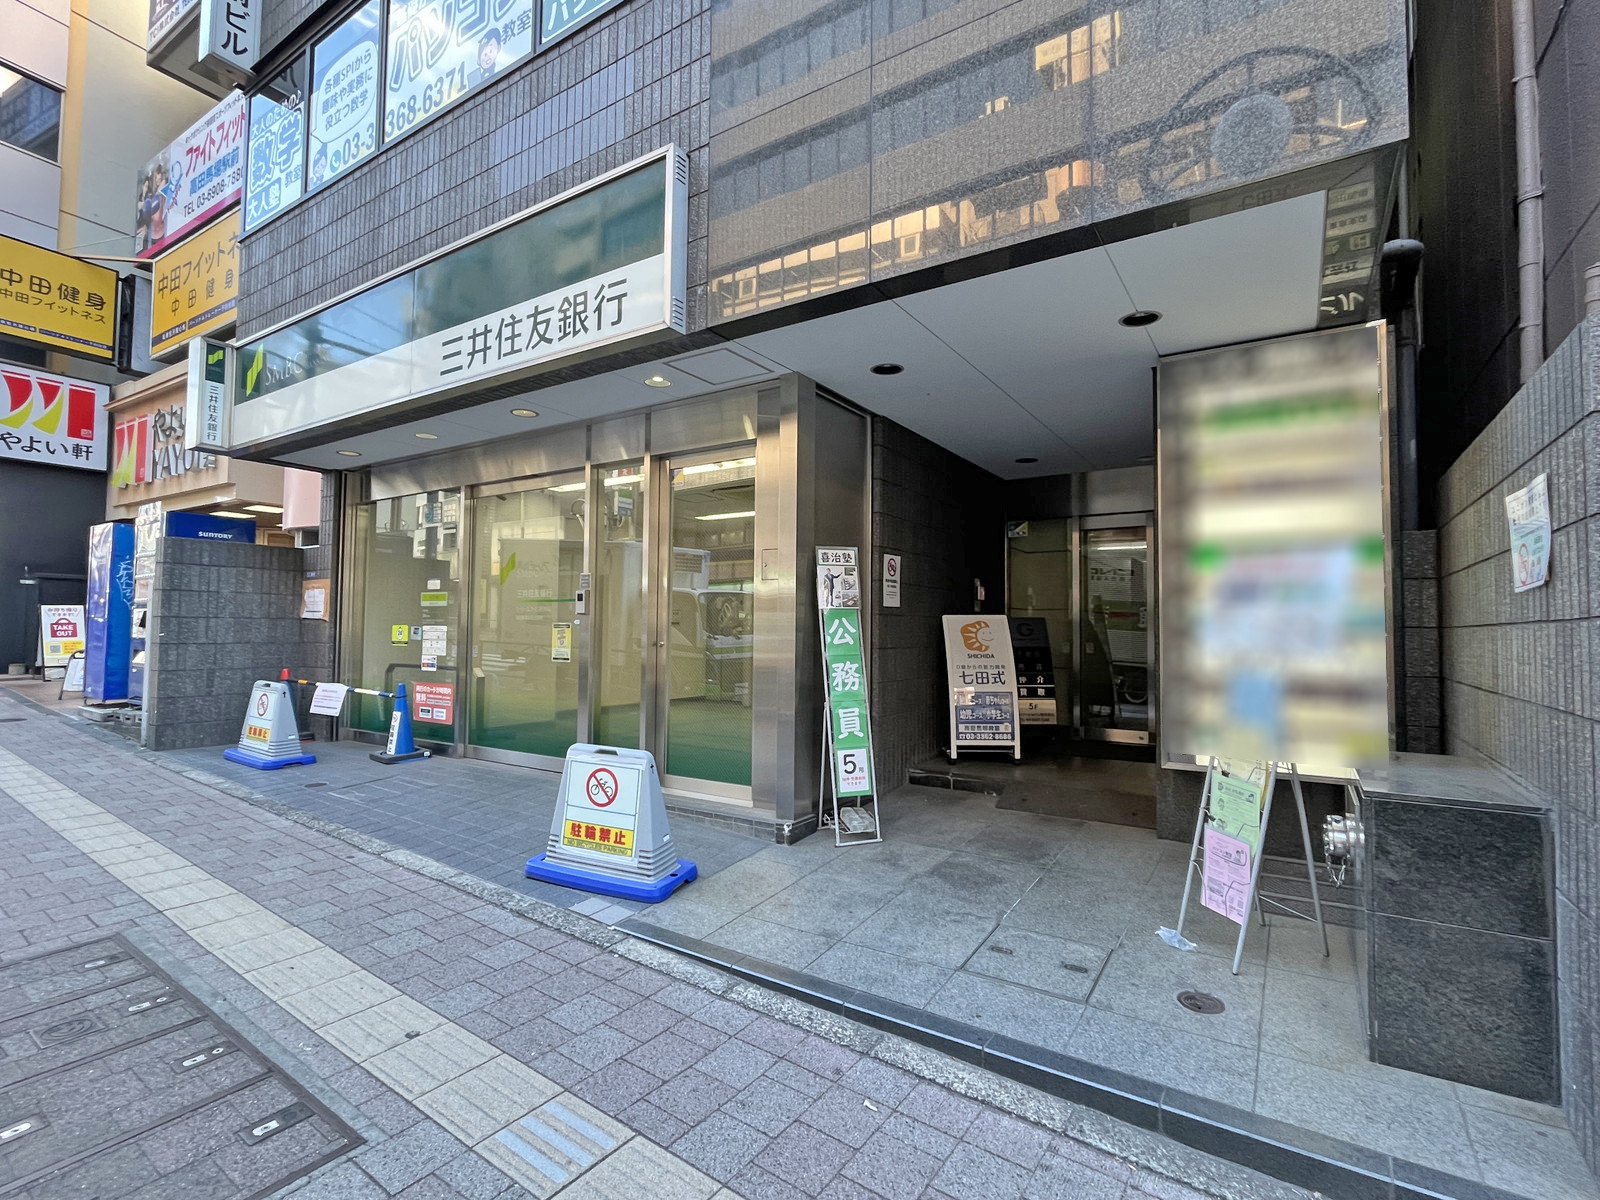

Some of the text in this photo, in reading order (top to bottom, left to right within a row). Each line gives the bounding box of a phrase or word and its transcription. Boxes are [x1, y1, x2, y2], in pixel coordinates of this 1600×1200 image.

[221, 0, 251, 55] ビル
[501, 8, 532, 45] 教室
[183, 195, 195, 218] TEL
[0, 268, 106, 311] 中田健身
[440, 278, 628, 376] 三井住友銀行
[207, 385, 220, 441] 三井住友銀行
[0, 431, 94, 461] やよい軒
[820, 551, 853, 564] 喜治塾
[828, 616, 865, 739] 公務員
[958, 670, 1006, 685] 七田式
[571, 822, 626, 846] 駐輪禁止
